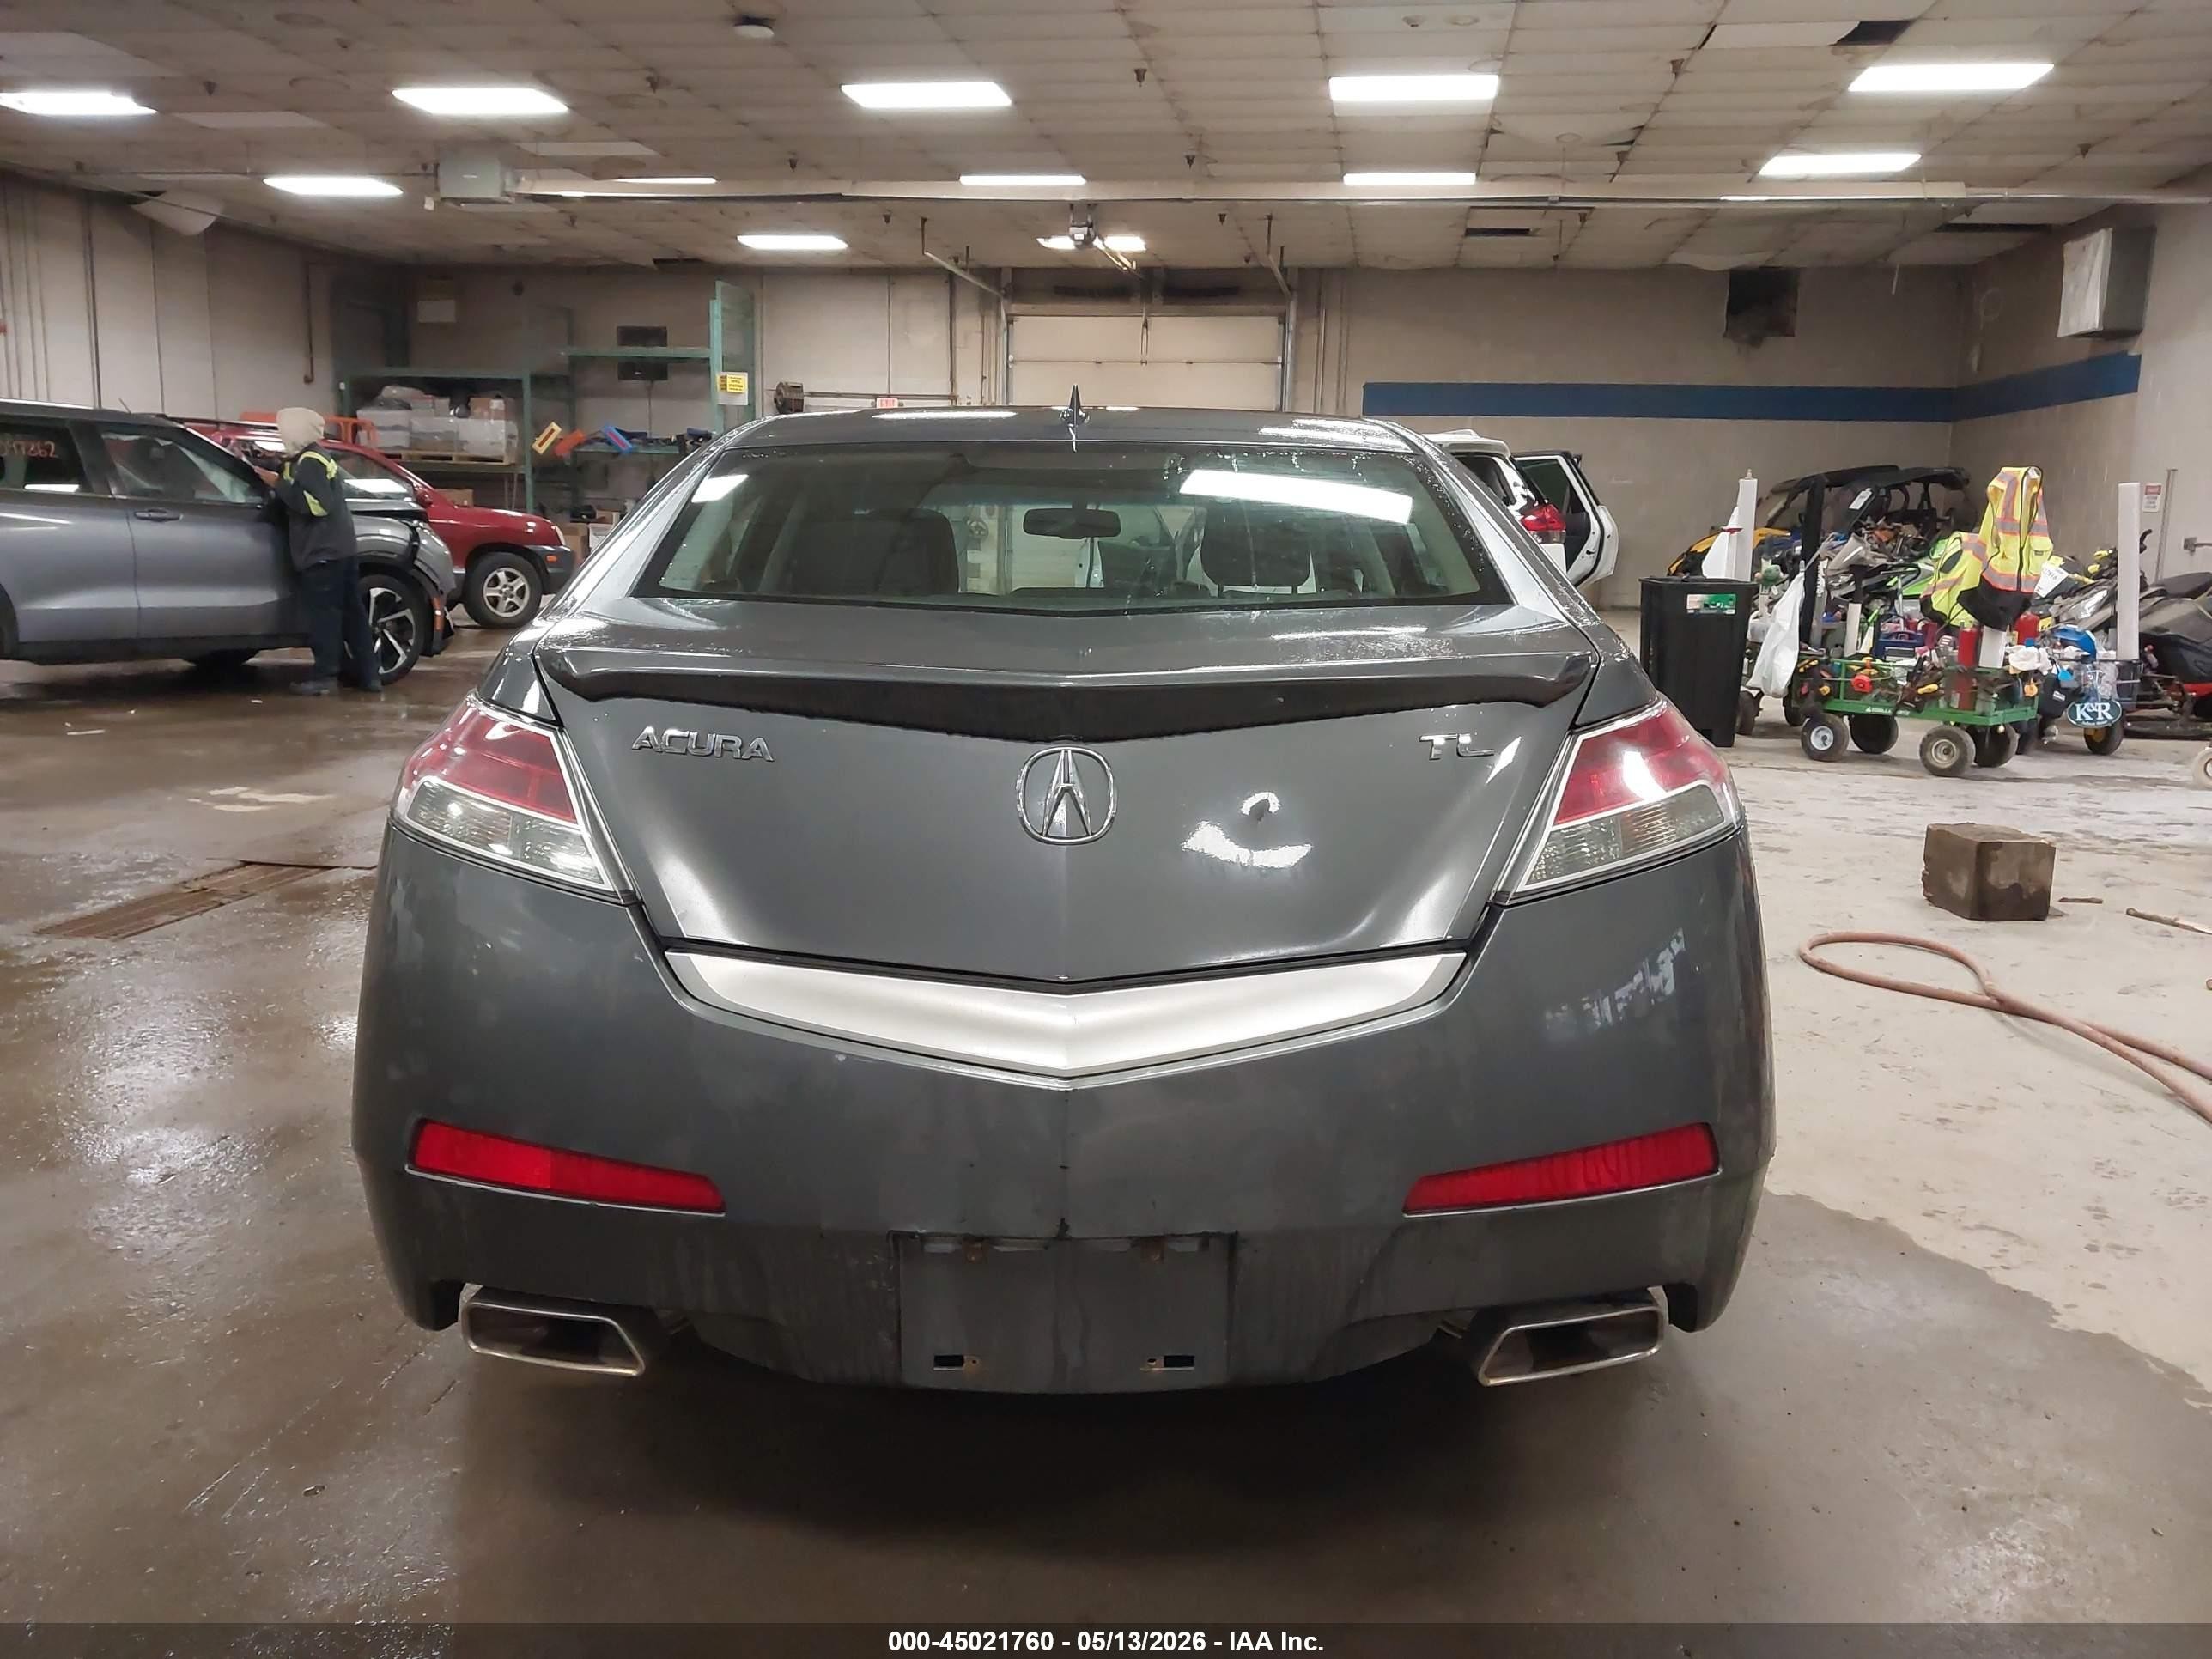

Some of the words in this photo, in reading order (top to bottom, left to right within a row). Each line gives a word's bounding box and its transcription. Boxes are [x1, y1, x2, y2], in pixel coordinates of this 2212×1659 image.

[2075, 702, 2114, 721] K&R
[632, 726, 775, 763] ACURA
[1419, 732, 1495, 761] TL
